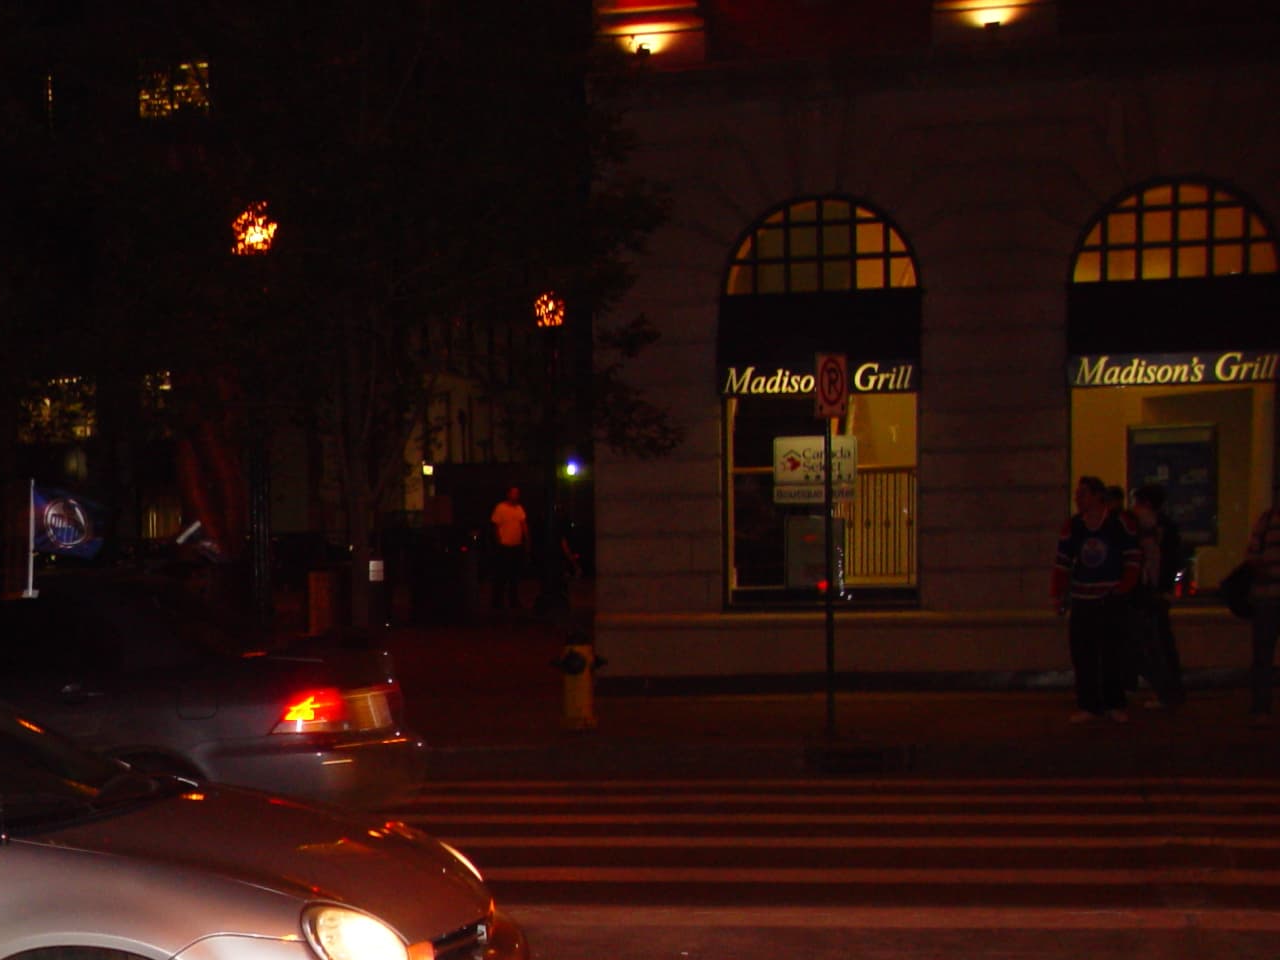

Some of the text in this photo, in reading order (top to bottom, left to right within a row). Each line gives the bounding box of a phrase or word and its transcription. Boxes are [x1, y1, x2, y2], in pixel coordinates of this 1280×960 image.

[723, 361, 913, 395] Madiso Grill
[1075, 351, 1278, 385] Madison's Grill
[802, 447, 852, 460] Canda
